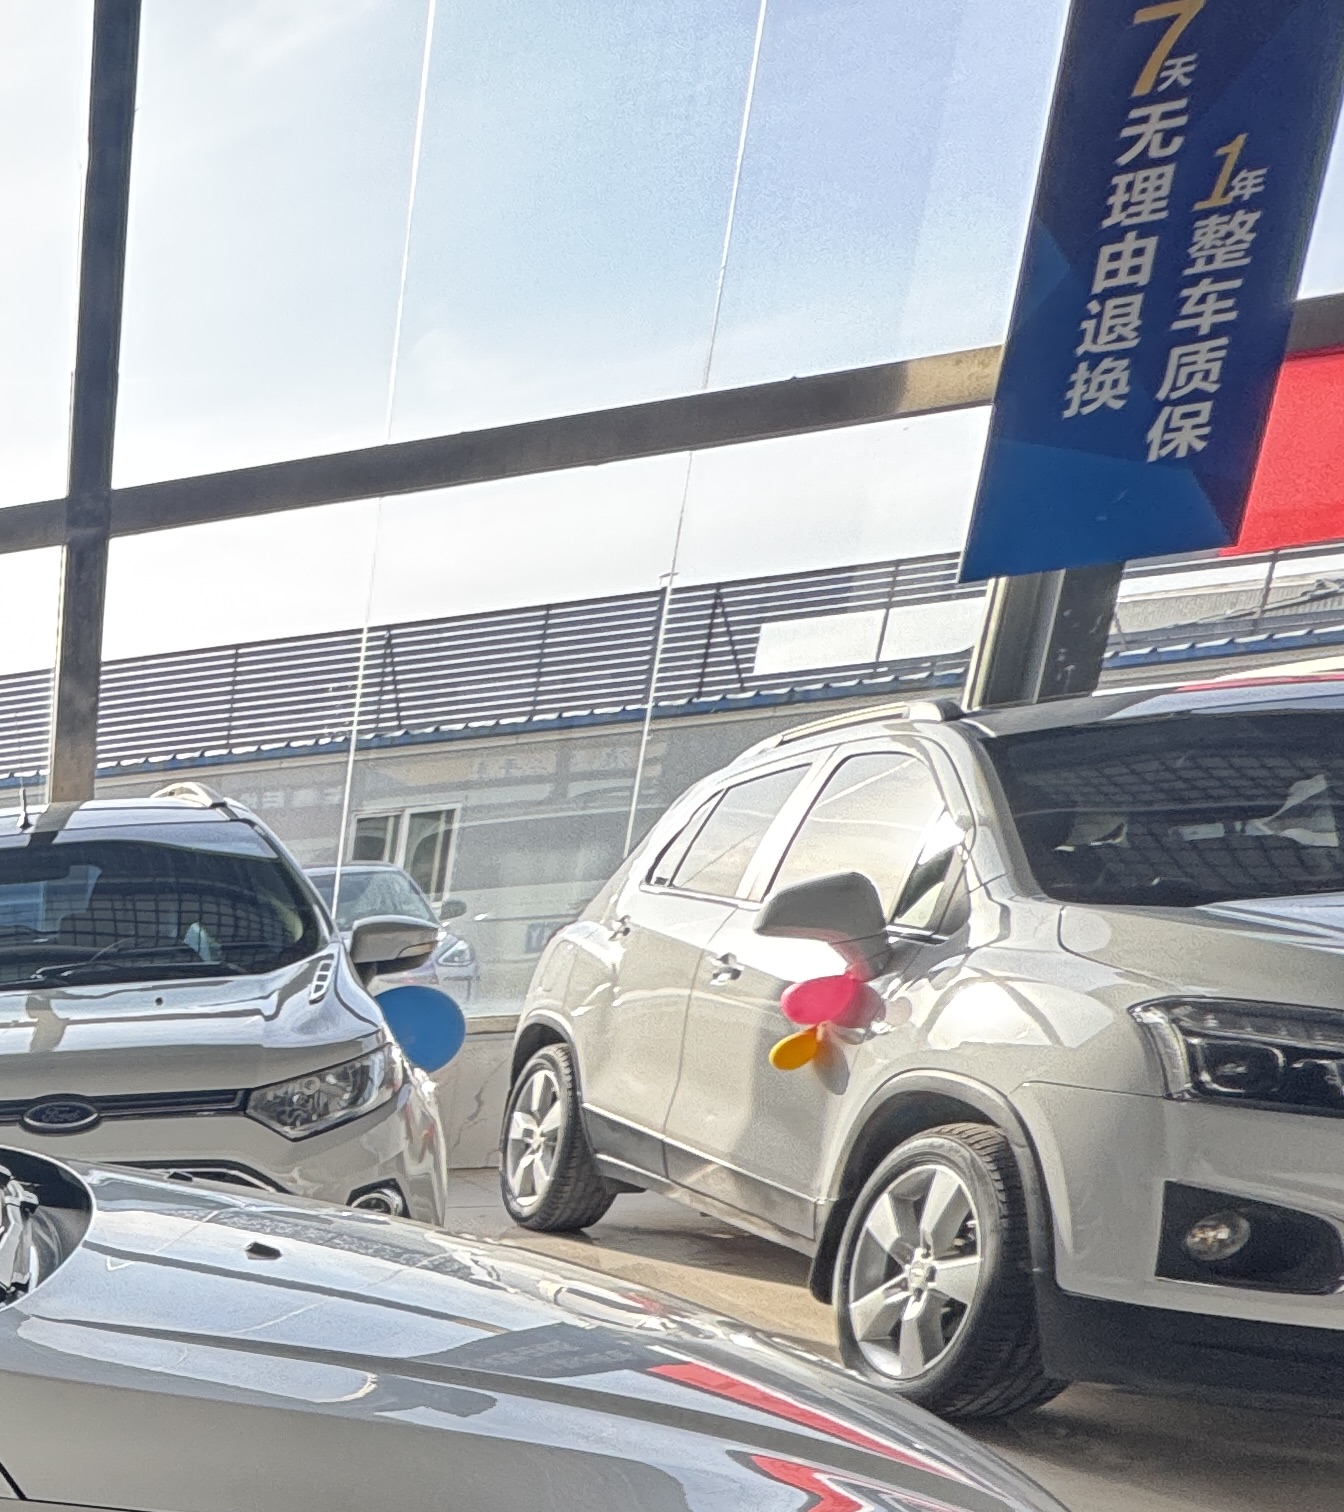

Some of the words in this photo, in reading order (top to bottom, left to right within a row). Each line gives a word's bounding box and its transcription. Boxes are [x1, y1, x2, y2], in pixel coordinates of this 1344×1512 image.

[1063, 0, 1206, 419] 7天无理由退换
[1146, 133, 1268, 463] 1年整车质保
